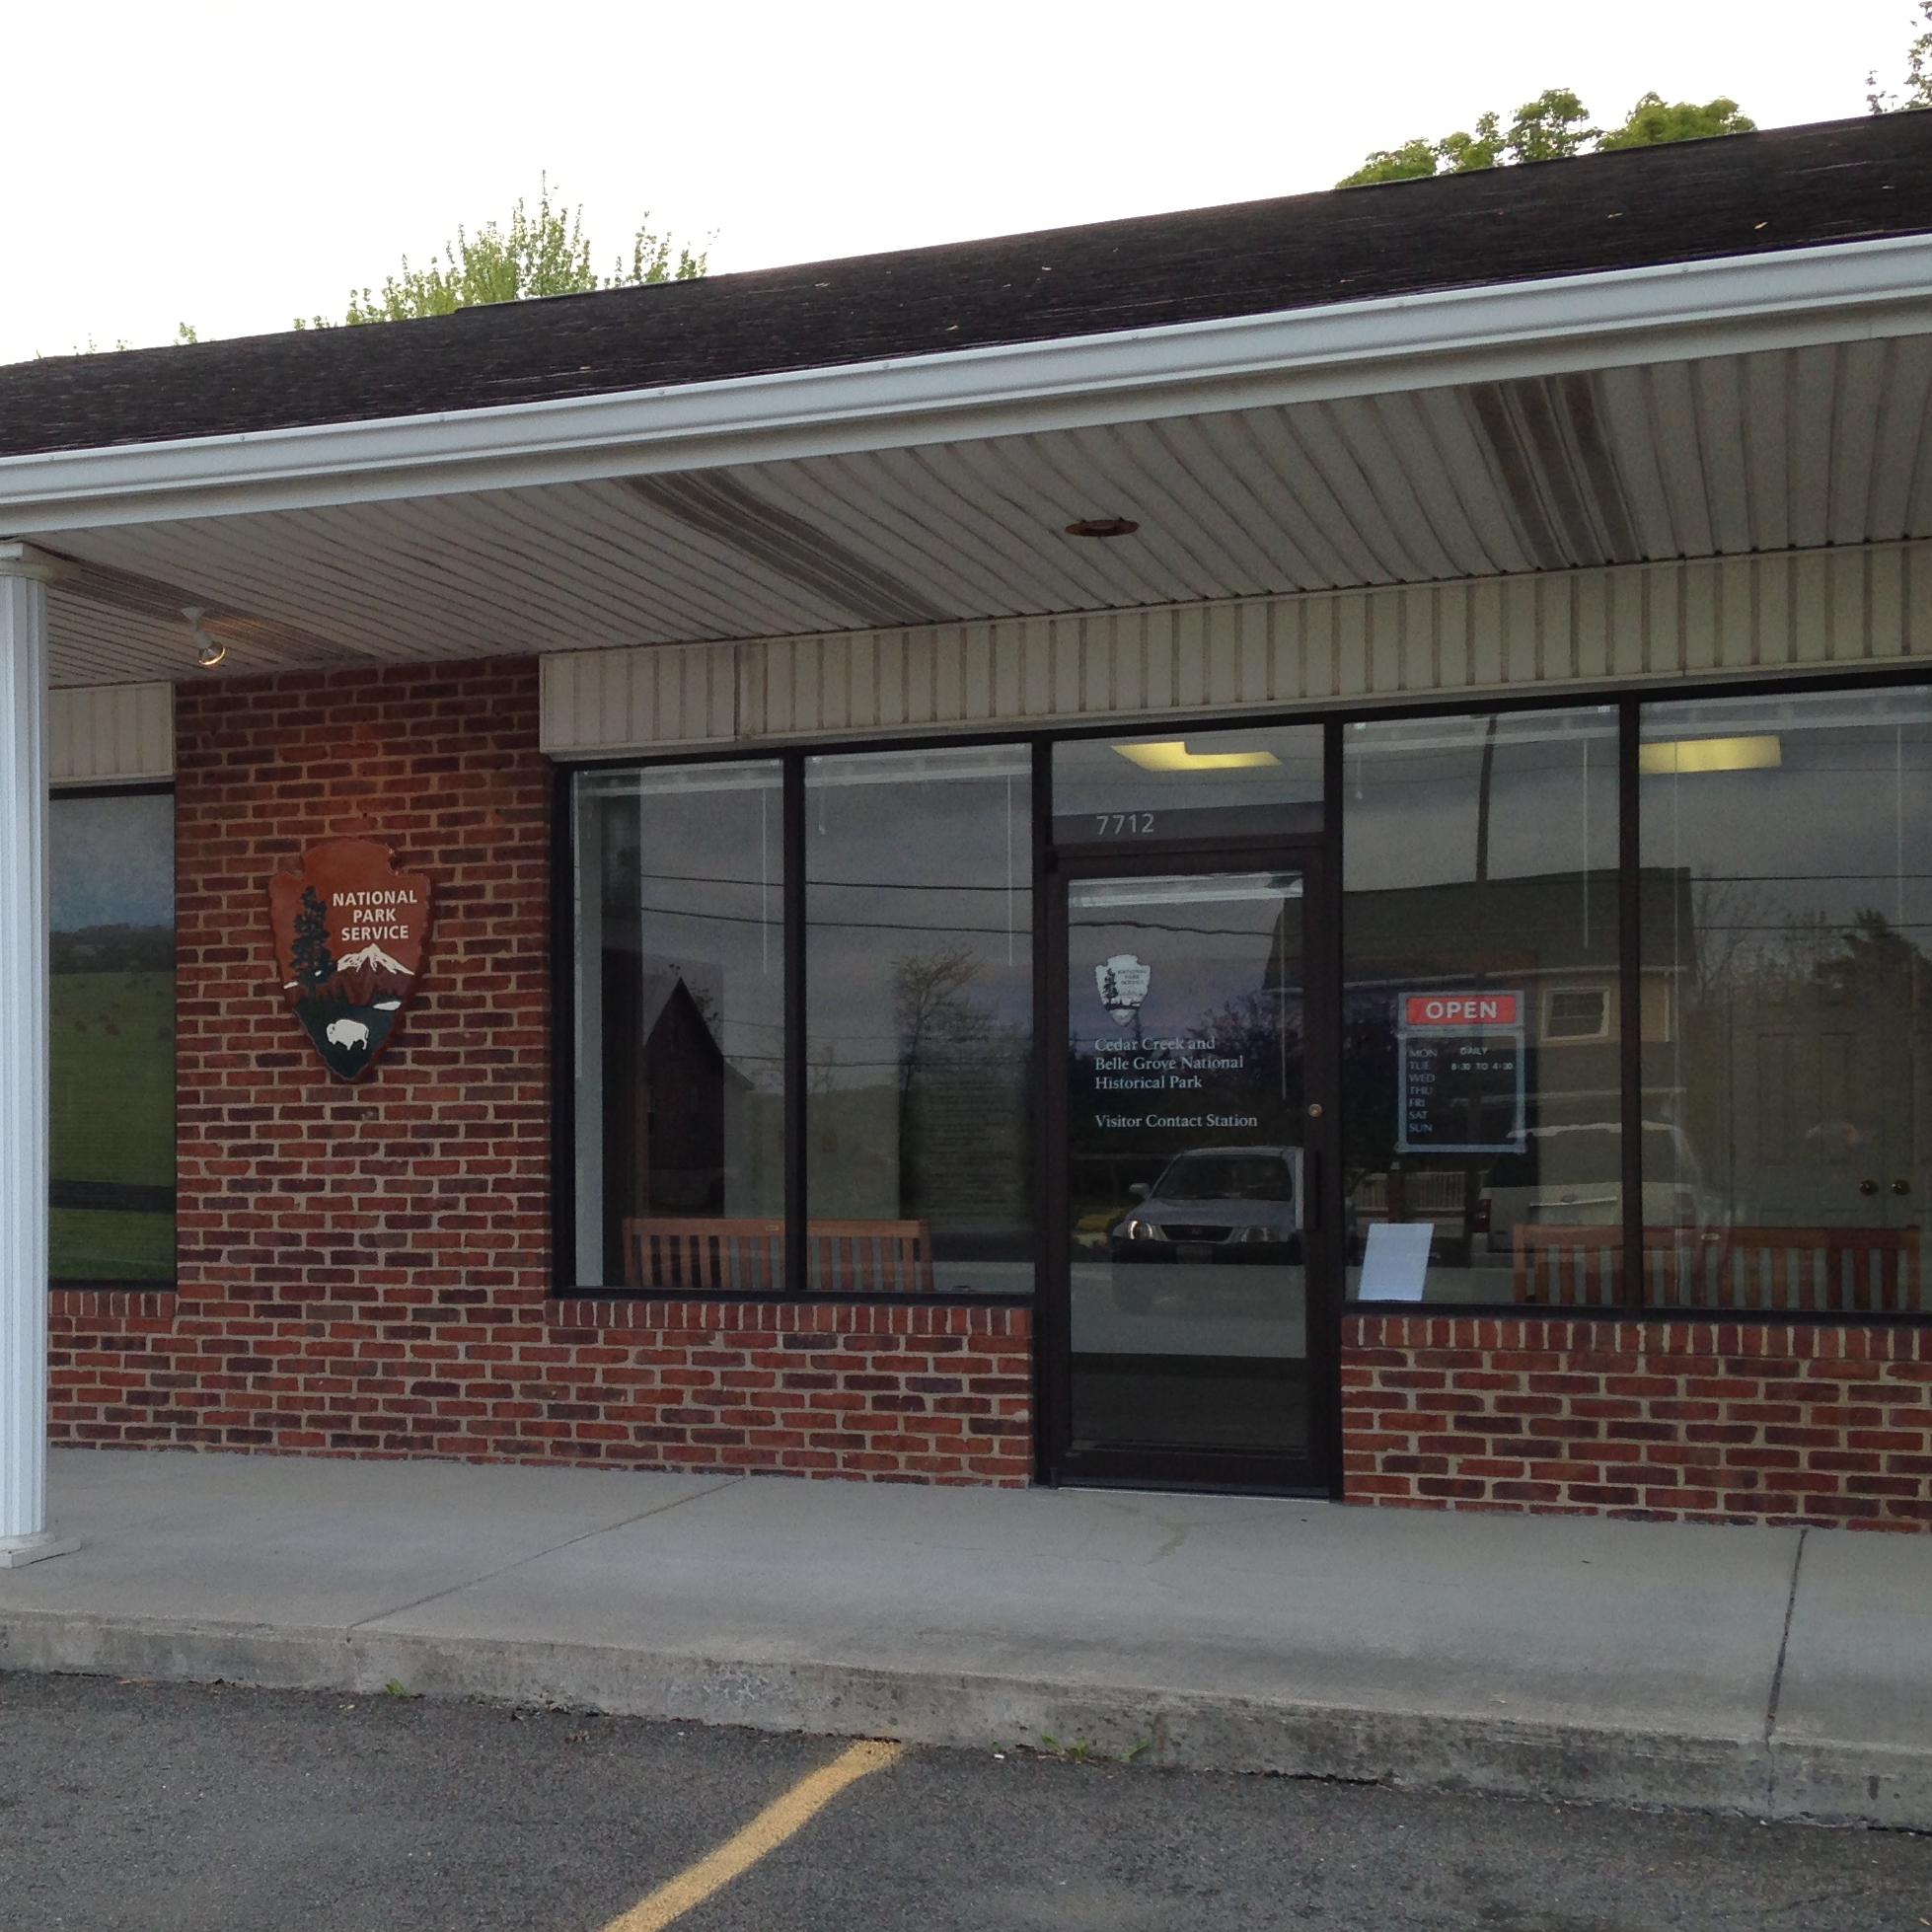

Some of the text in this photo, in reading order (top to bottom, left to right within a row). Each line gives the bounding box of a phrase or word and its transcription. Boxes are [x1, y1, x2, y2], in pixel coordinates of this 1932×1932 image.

[1096, 813, 1154, 836] 7712
[333, 890, 418, 907] NATIONAL
[353, 908, 397, 924] PARK
[341, 925, 409, 941] SERVICE
[1426, 1001, 1498, 1019] OPEN
[1094, 1036, 1216, 1052] Cedar Creek and
[1407, 1048, 1438, 1059] MON
[1095, 1055, 1244, 1071] Belle Grove National
[1475, 1062, 1489, 1072] TO
[1095, 1076, 1203, 1089] Historical Park
[1408, 1073, 1436, 1082] WED
[1095, 1113, 1258, 1128] Visitor Contact Station
[1408, 1110, 1429, 1120] SAT
[1408, 1123, 1434, 1133] SUN
